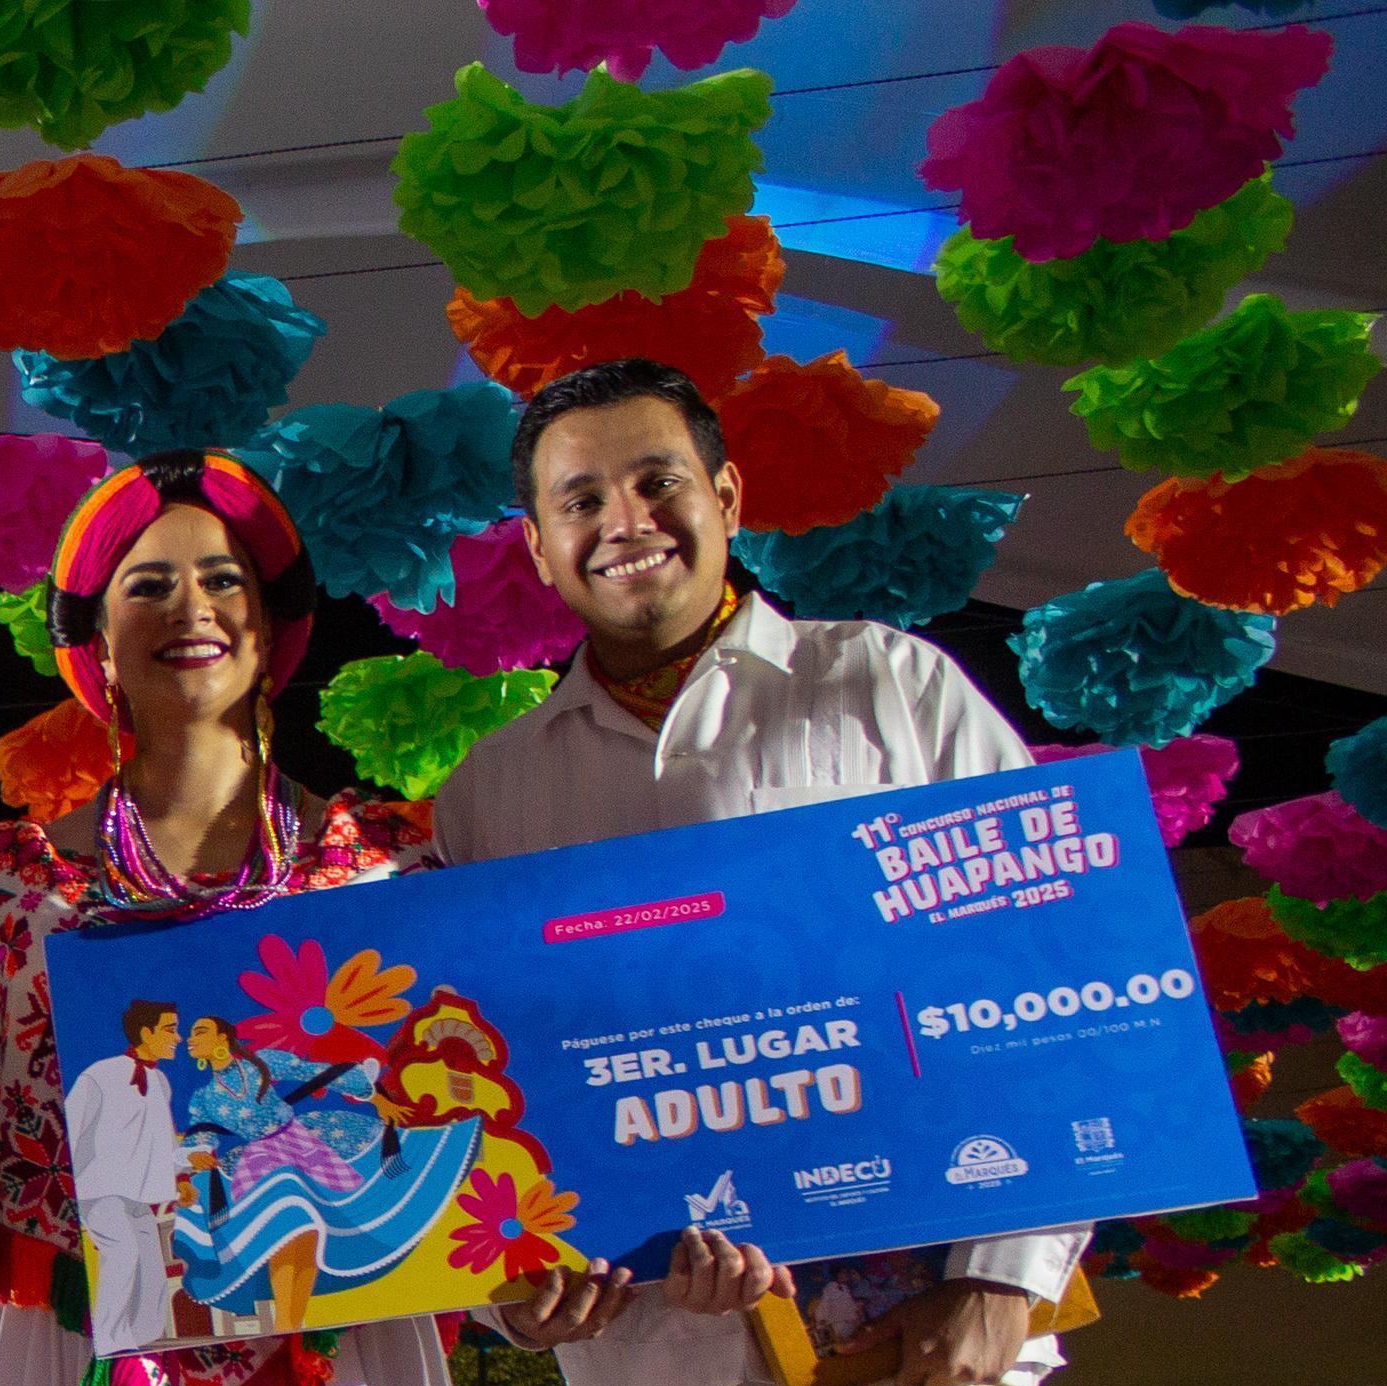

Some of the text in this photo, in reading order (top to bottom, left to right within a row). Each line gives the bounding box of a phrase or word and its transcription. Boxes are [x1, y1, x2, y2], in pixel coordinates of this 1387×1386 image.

[876, 801, 1081, 882] BAILE DE
[898, 808, 975, 838] CONCURSO
[976, 790, 1048, 816] NACIONAL
[1051, 785, 1073, 798] DE
[873, 832, 1119, 923] HUAPANGO
[929, 880, 1074, 924] EL MARQUÉS 2025
[555, 901, 711, 936] Fecha: 22/02/2025
[561, 996, 860, 1050] Páguese por este cheque a la orden de:
[917, 969, 1194, 1039] $10,000.00
[584, 1020, 861, 1087] 3ER. LUGAR
[1033, 1032, 1071, 1046] pesos
[614, 1064, 862, 1145] ADULTO
